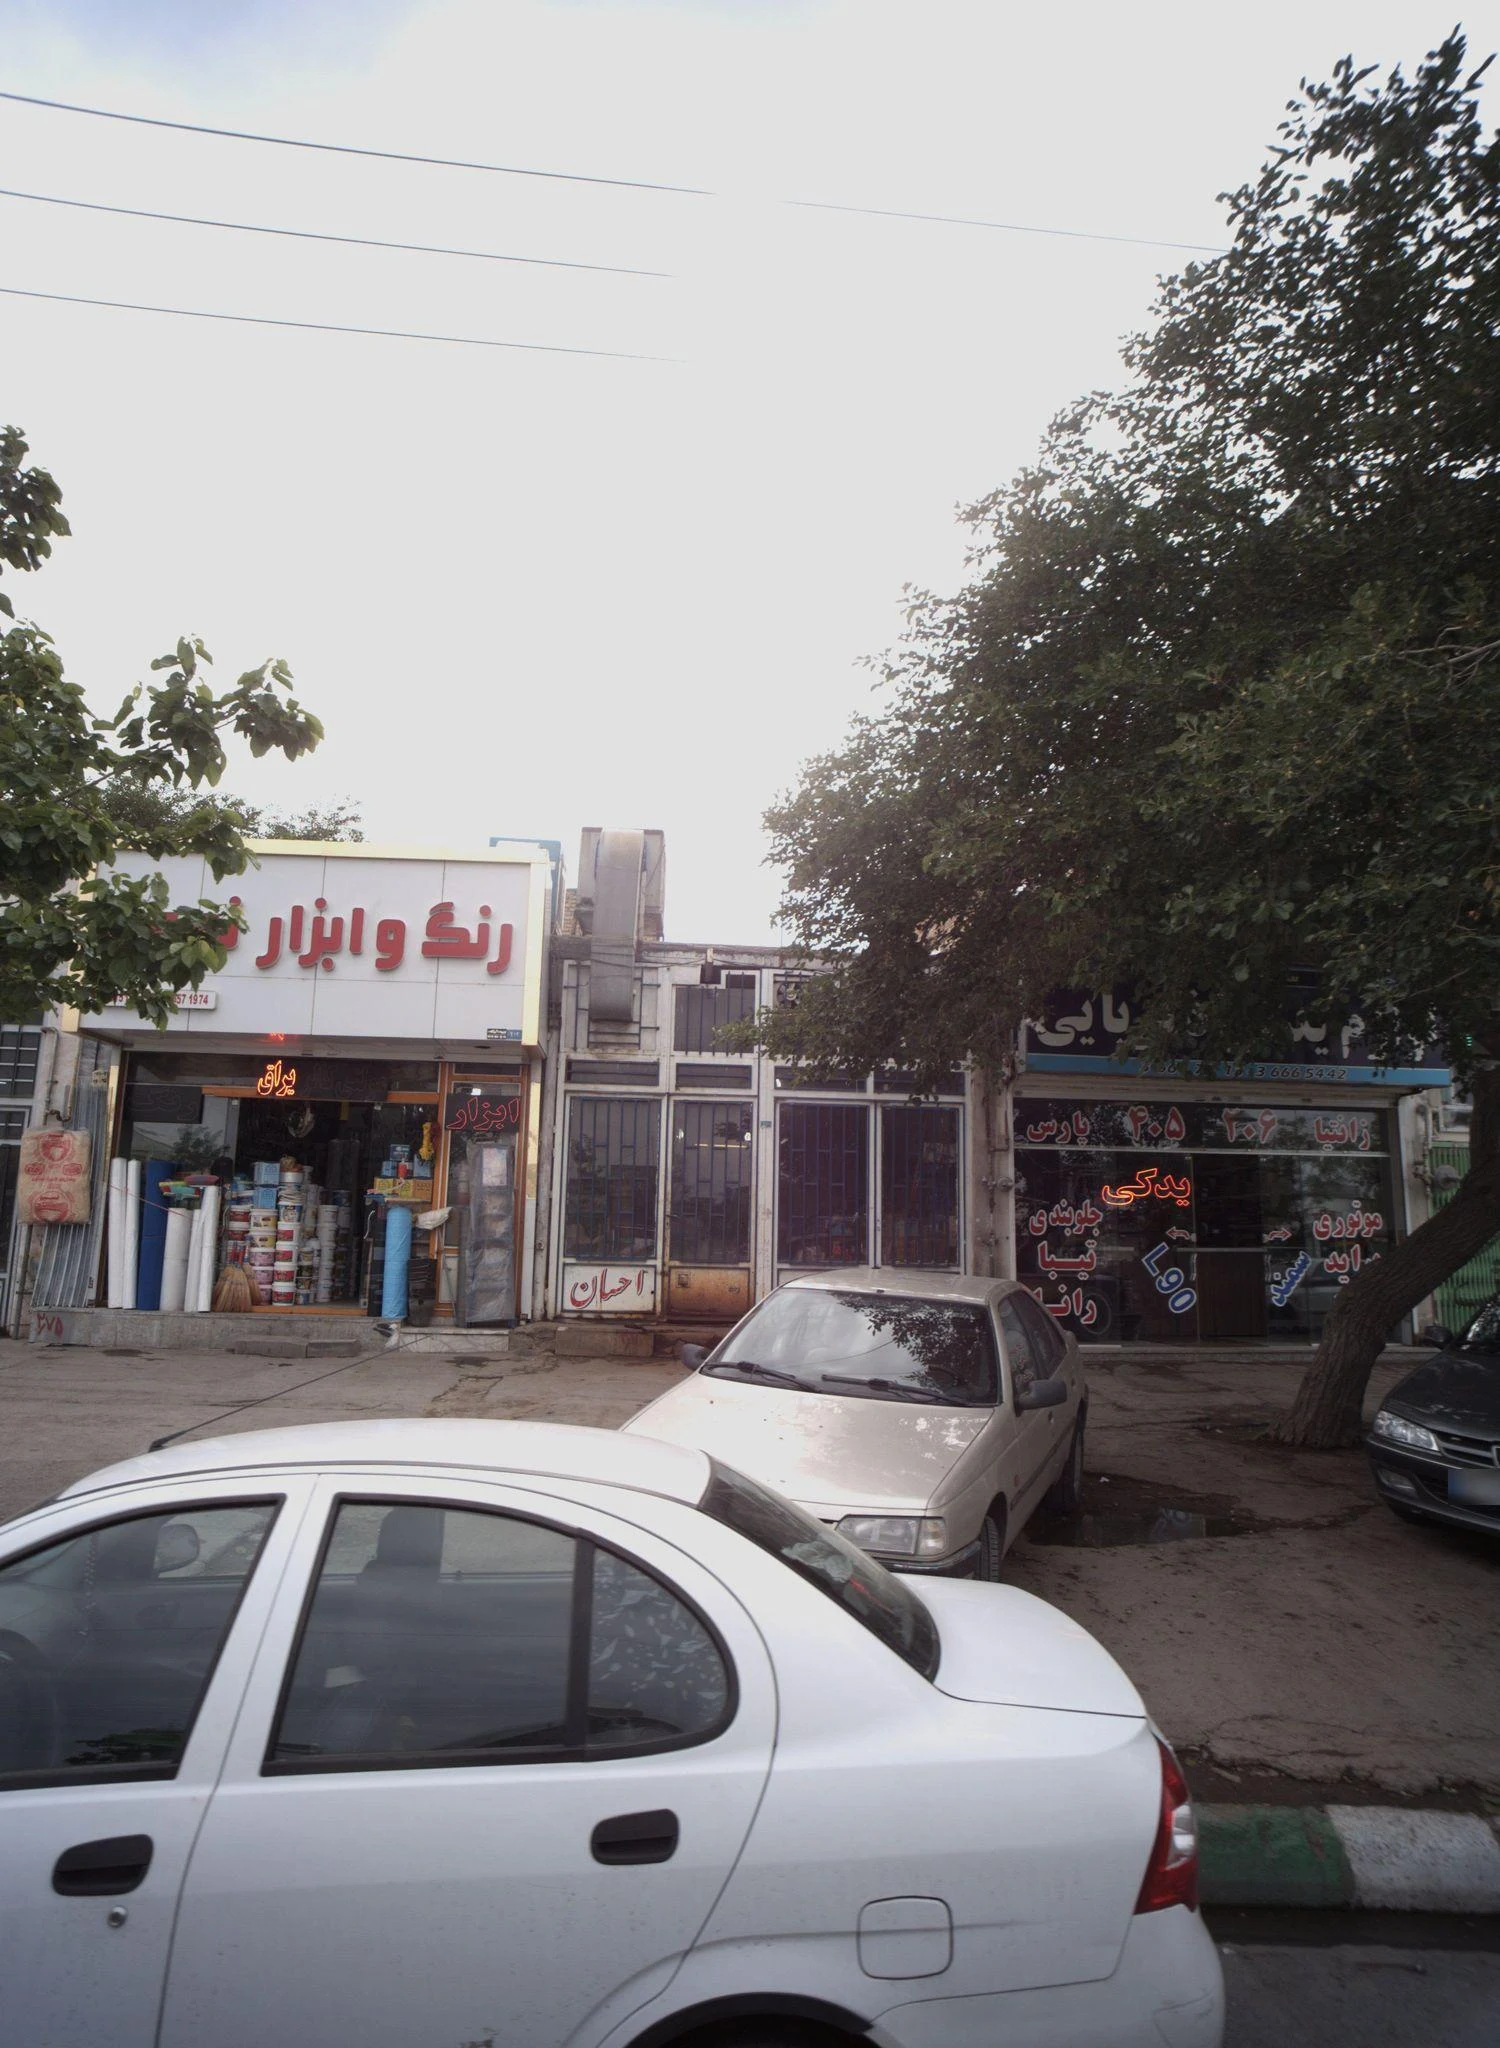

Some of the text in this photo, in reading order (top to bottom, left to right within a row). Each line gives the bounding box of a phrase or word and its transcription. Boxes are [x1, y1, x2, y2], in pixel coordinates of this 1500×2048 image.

[255, 897, 365, 972] ابزار
[375, 918, 407, 971] و
[421, 901, 513, 975] رنگ
[189, 994, 208, 1005] 1974
[257, 1060, 296, 1097] یراق
[1270, 1067, 1301, 1079] 666
[1305, 1068, 1347, 1081] 5442
[446, 1097, 521, 1130] ابزار
[1027, 1110, 1090, 1146] پارس
[1128, 1106, 1186, 1141] ۴۰۵
[1222, 1107, 1279, 1145] ۲۰۶
[1314, 1114, 1371, 1152] زانتیا
[1101, 1167, 1192, 1207] یدکی
[1029, 1198, 1104, 1237] جلوبندی
[1312, 1200, 1384, 1240] موتوری
[1038, 1239, 1097, 1281] تیبا
[1141, 1241, 1198, 1314] L90
[1270, 1249, 1313, 1307] سمند
[570, 1266, 645, 1309] احسان
